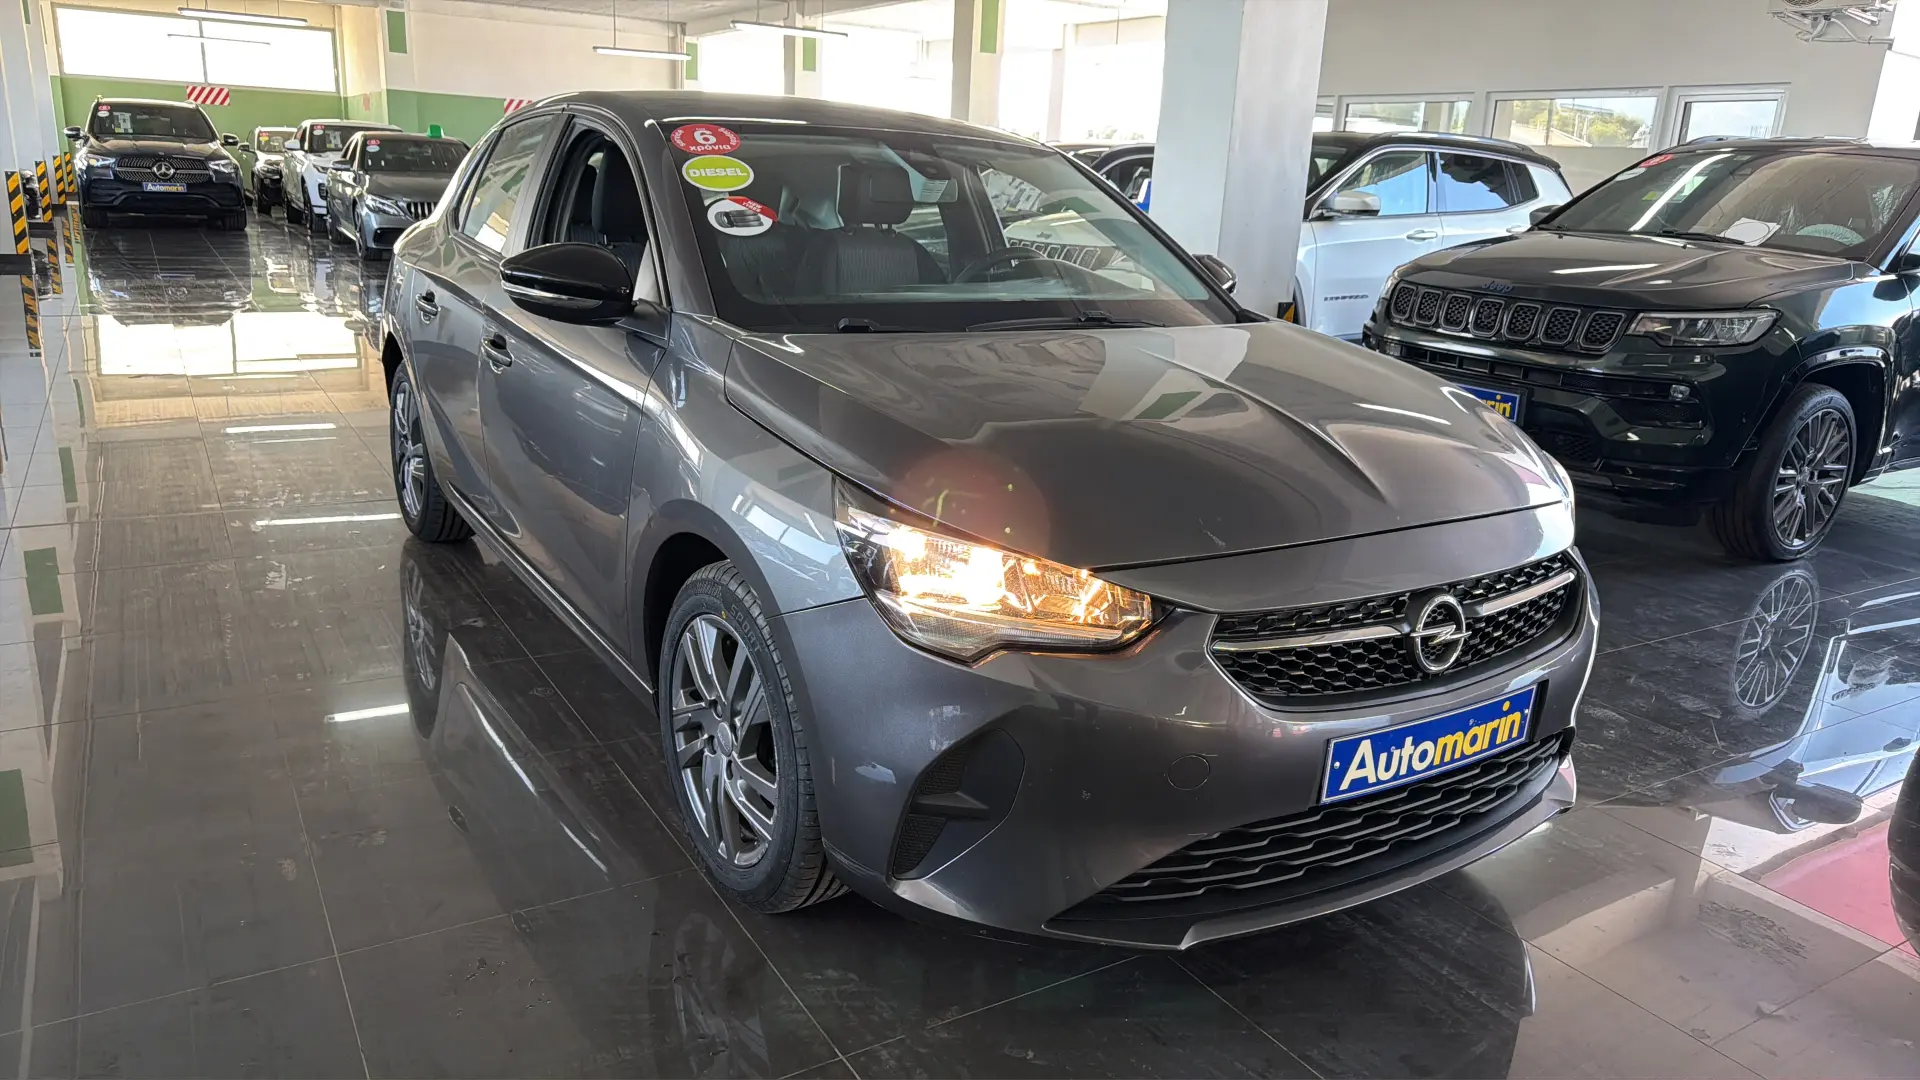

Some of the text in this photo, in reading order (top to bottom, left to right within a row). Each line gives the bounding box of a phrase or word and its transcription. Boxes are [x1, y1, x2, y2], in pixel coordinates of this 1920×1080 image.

[694, 130, 717, 144] 6
[689, 168, 747, 177] DIESEL
[147, 183, 184, 191] Automarin
[1482, 280, 1515, 294] Jeep
[730, 603, 766, 653] SPORT
[1338, 700, 1522, 791] Automarin
